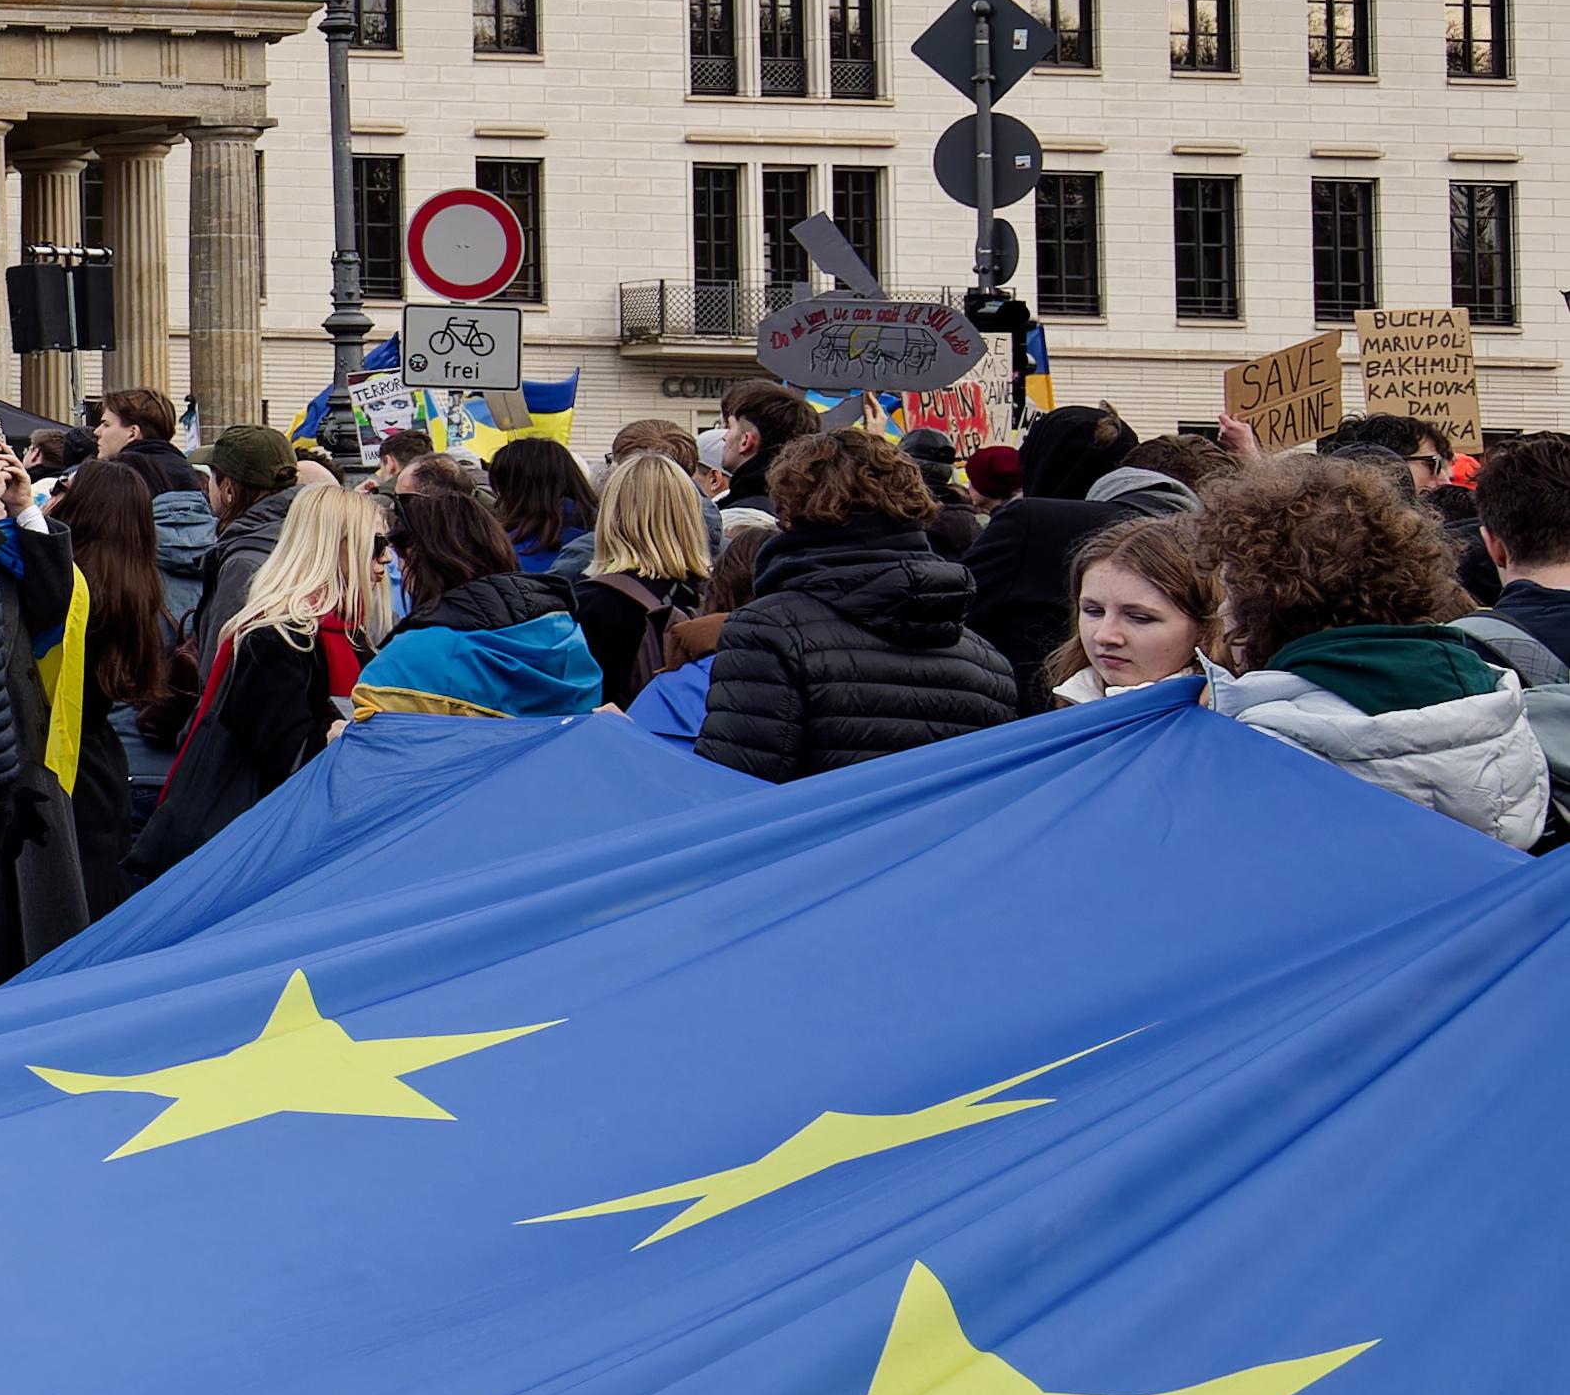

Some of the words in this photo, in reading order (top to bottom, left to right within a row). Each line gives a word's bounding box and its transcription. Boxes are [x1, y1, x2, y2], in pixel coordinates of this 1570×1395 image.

[1373, 311, 1455, 330] BUCHA
[444, 361, 480, 379] frei
[1240, 341, 1327, 410] SAVE
[1365, 354, 1473, 378] BAKHMUT
[353, 377, 404, 402] TERROR
[1368, 378, 1476, 402] KAKHOVKA
[918, 386, 976, 419] PUTIN
[1408, 401, 1450, 417] DAM
[1246, 387, 1335, 449] KRAINE
